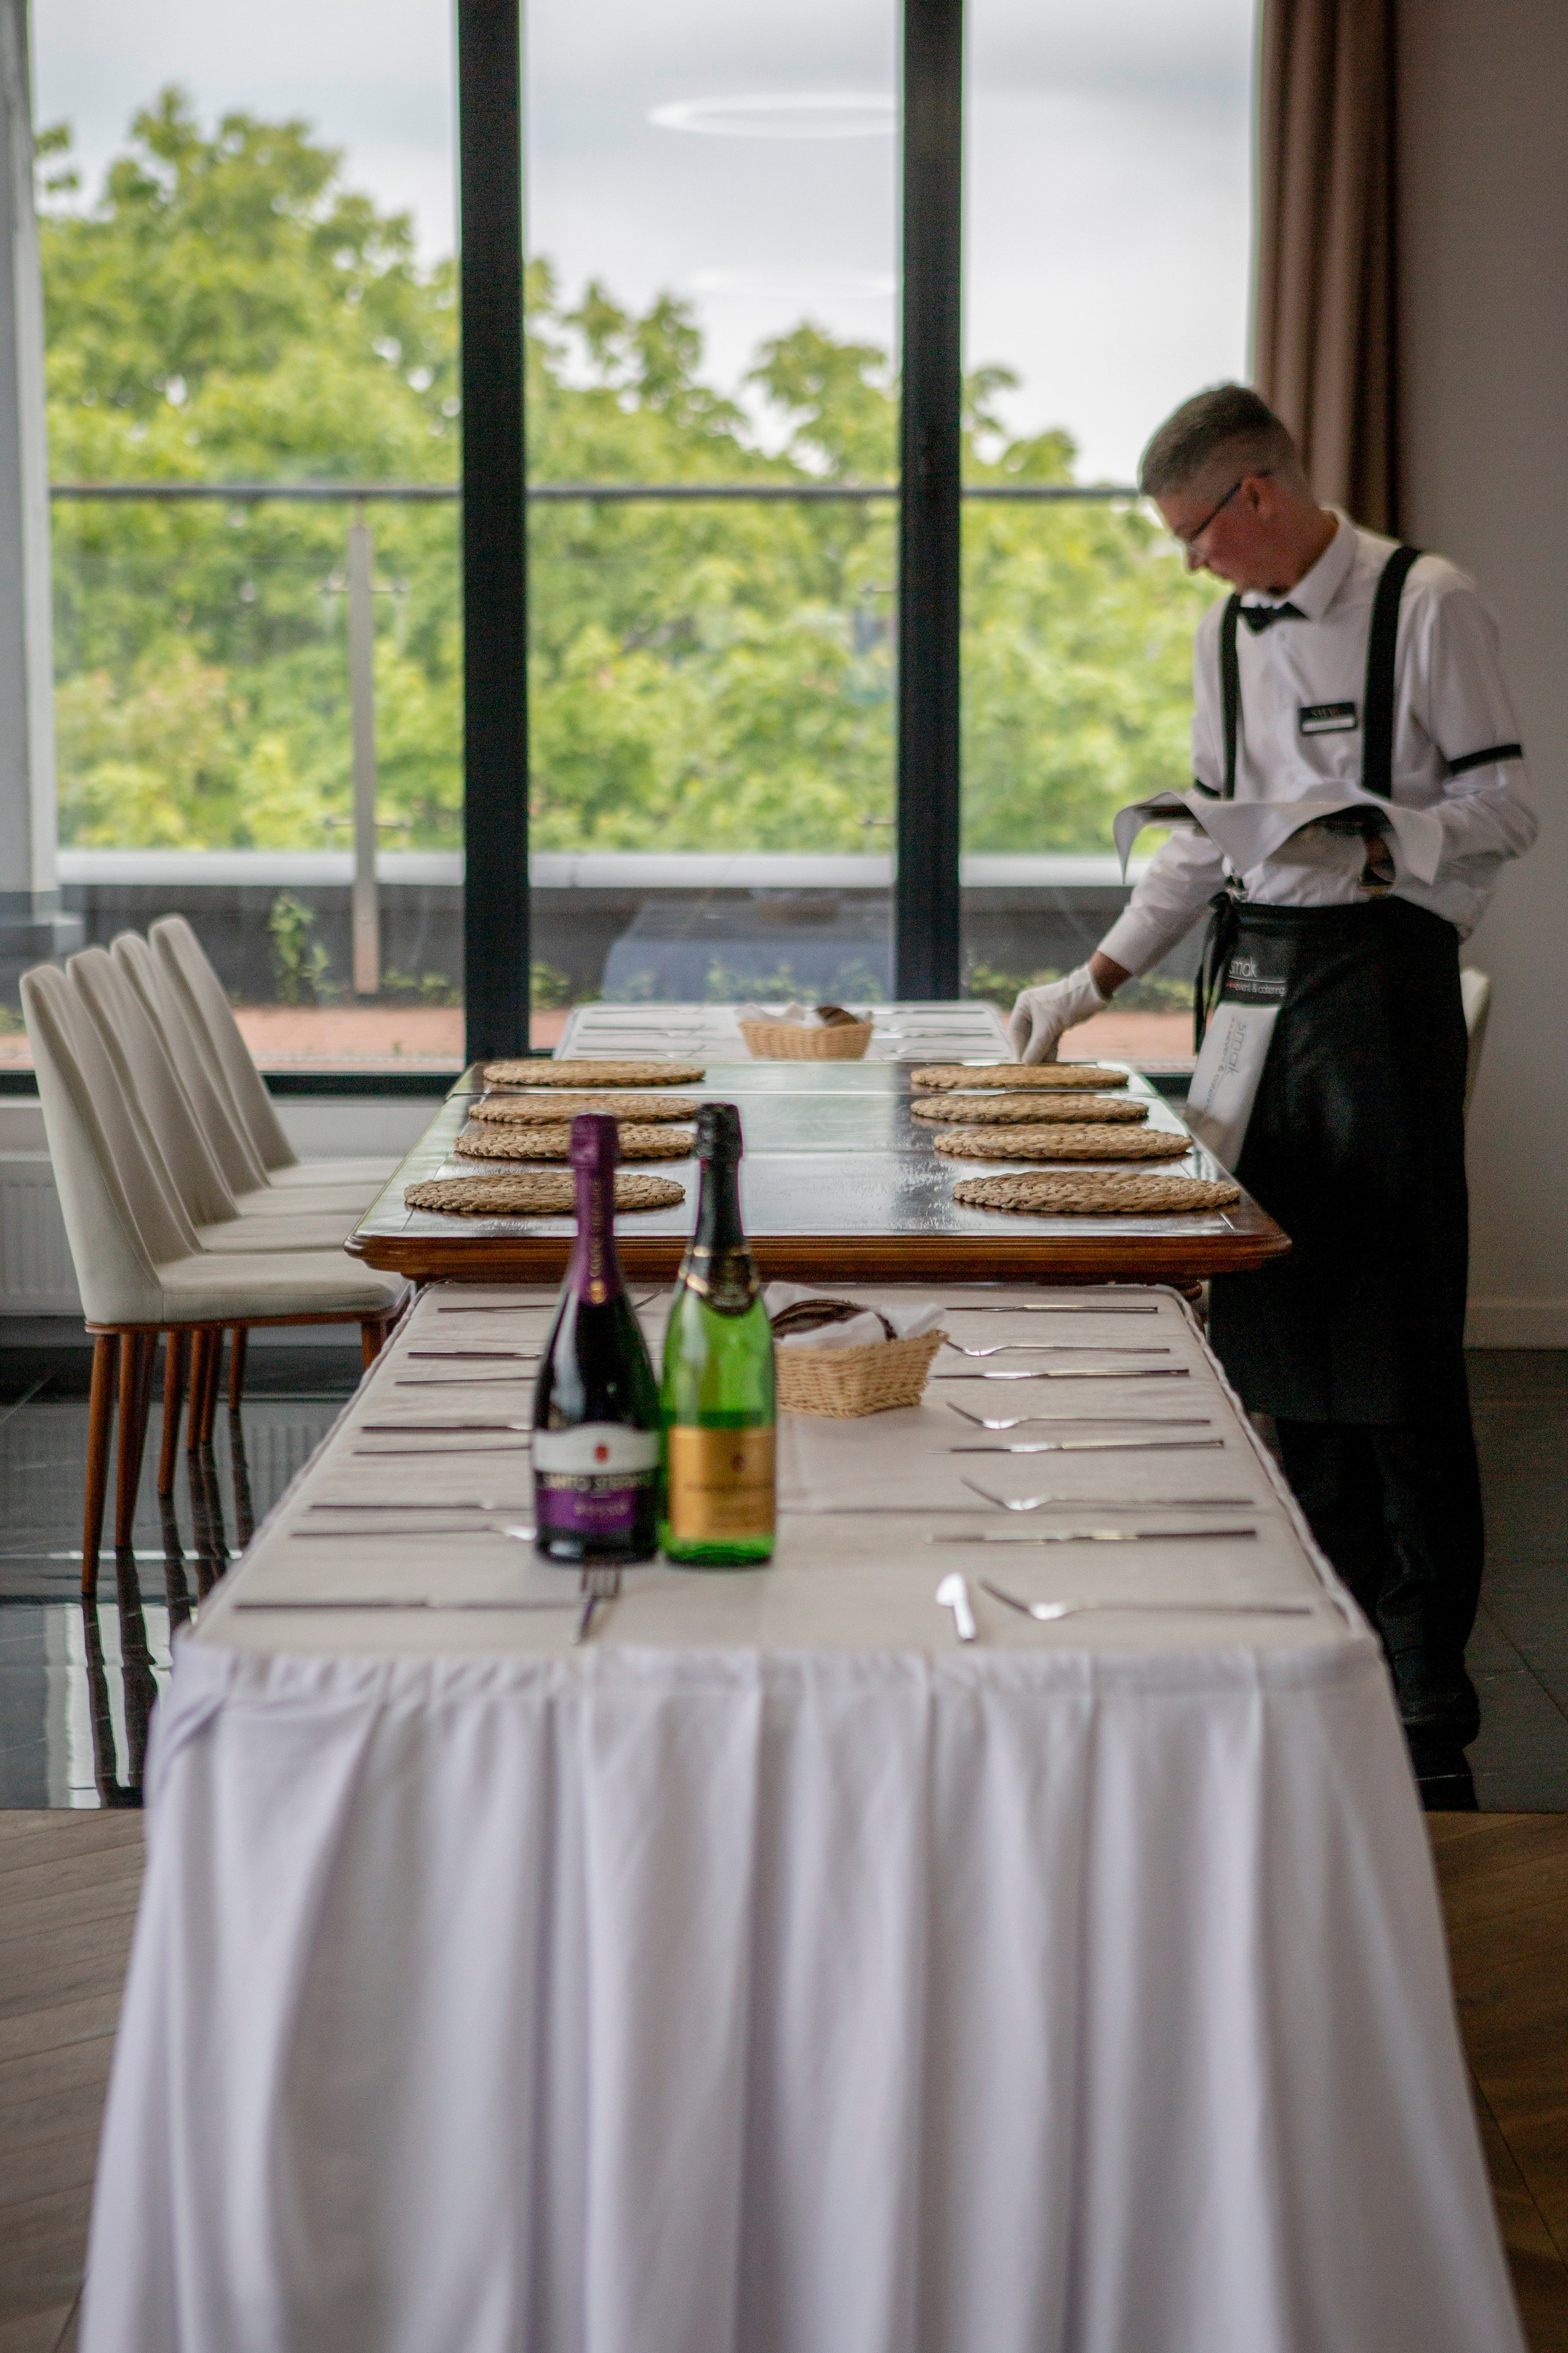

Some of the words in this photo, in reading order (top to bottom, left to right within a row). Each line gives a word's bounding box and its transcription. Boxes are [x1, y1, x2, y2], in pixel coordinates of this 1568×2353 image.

[1229, 956, 1257, 978] smak
[1221, 1035, 1231, 1063] event
[1226, 1021, 1246, 1077] smak
